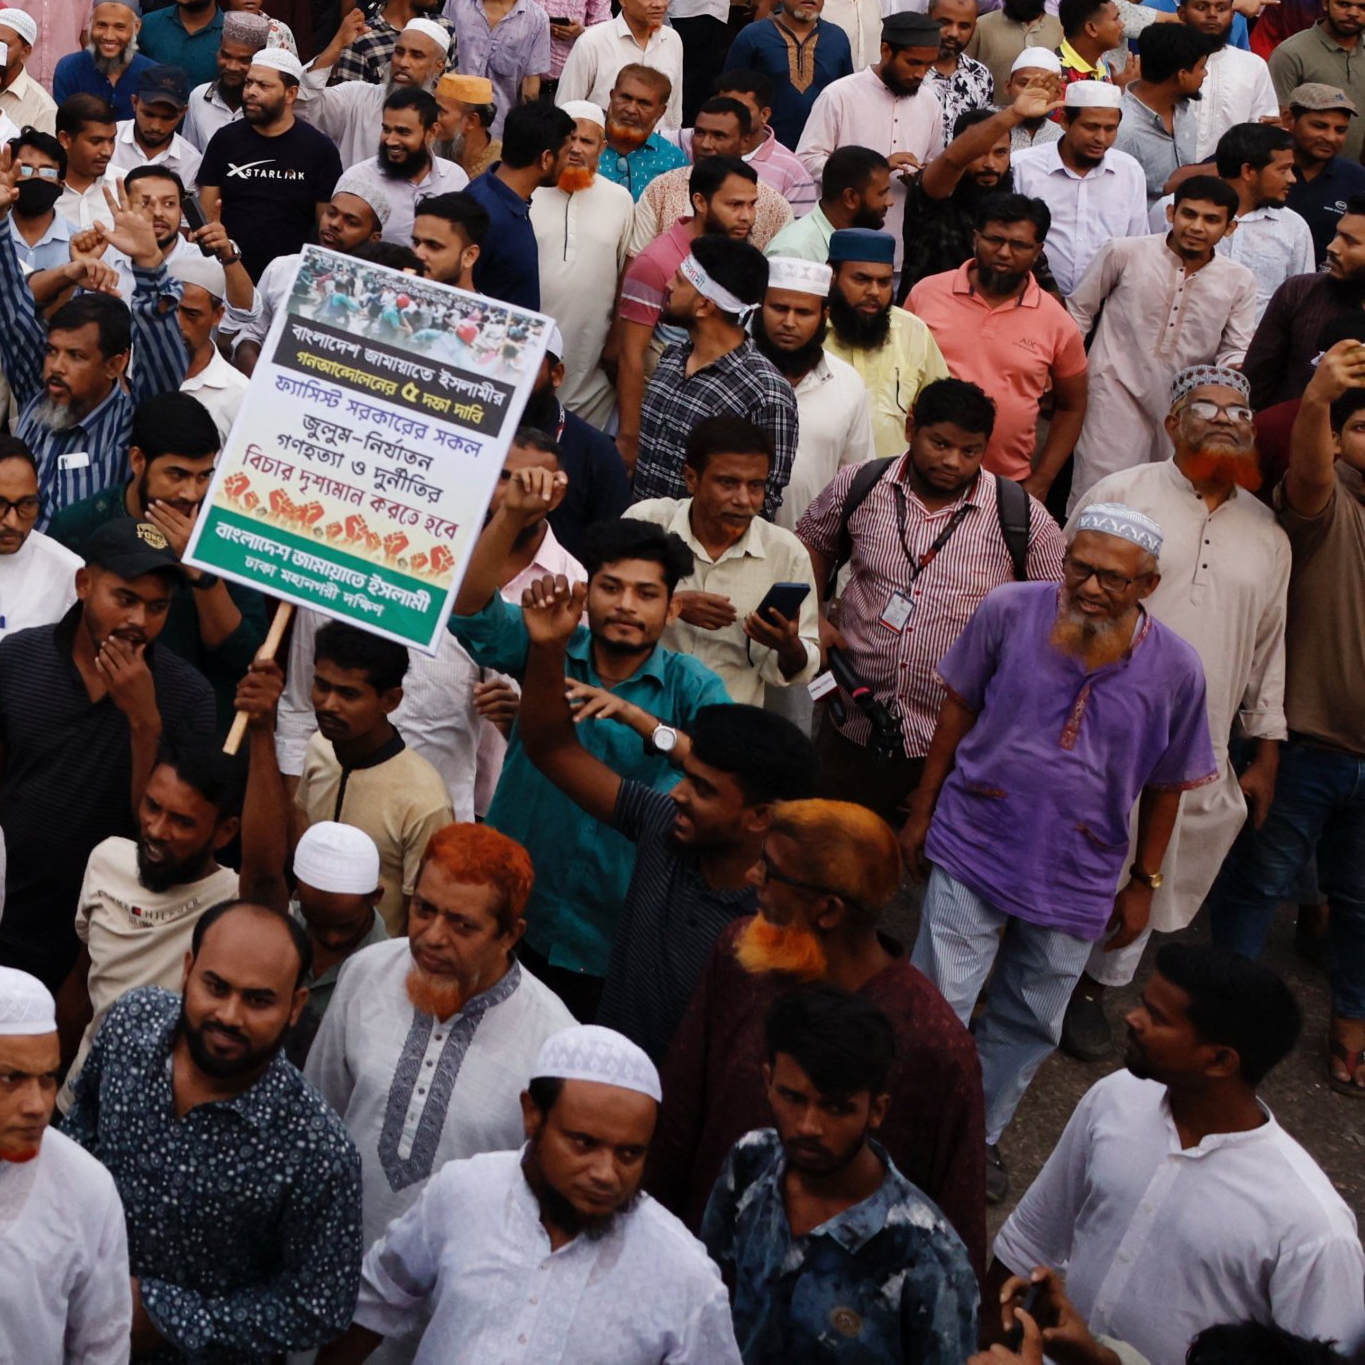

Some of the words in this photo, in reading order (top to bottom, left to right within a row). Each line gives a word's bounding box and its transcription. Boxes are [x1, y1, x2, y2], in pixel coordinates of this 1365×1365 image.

[245, 168, 305, 180] STARLINK
[291, 323, 361, 358] বাংলাদেশ
[364, 347, 435, 381] জামায়াতে
[438, 367, 506, 406] ইসলামীর
[400, 382, 419, 402] ৫
[421, 392, 451, 413] দফা
[453, 402, 484, 423] দাবি
[275, 375, 342, 407] ফ্যাসিস্ট
[345, 398, 429, 439] সরকারের
[433, 428, 483, 457] সকল
[242, 447, 295, 481] বিচার
[299, 469, 365, 506] দৃশ্যমান
[369, 493, 421, 525] করতে
[423, 513, 459, 539] হবে
[277, 433, 345, 468] গণহত্যা
[351, 461, 365, 475] ও
[373, 466, 443, 503] দুর্নীতির
[215, 522, 292, 561] বাংলাদেশ
[291, 548, 367, 588] জামায়াতে
[367, 573, 431, 612] ইসলামী
[244, 555, 277, 577] ঢাকা
[280, 568, 340, 600] মহানগরী
[342, 591, 384, 617] দক্ষিণ
